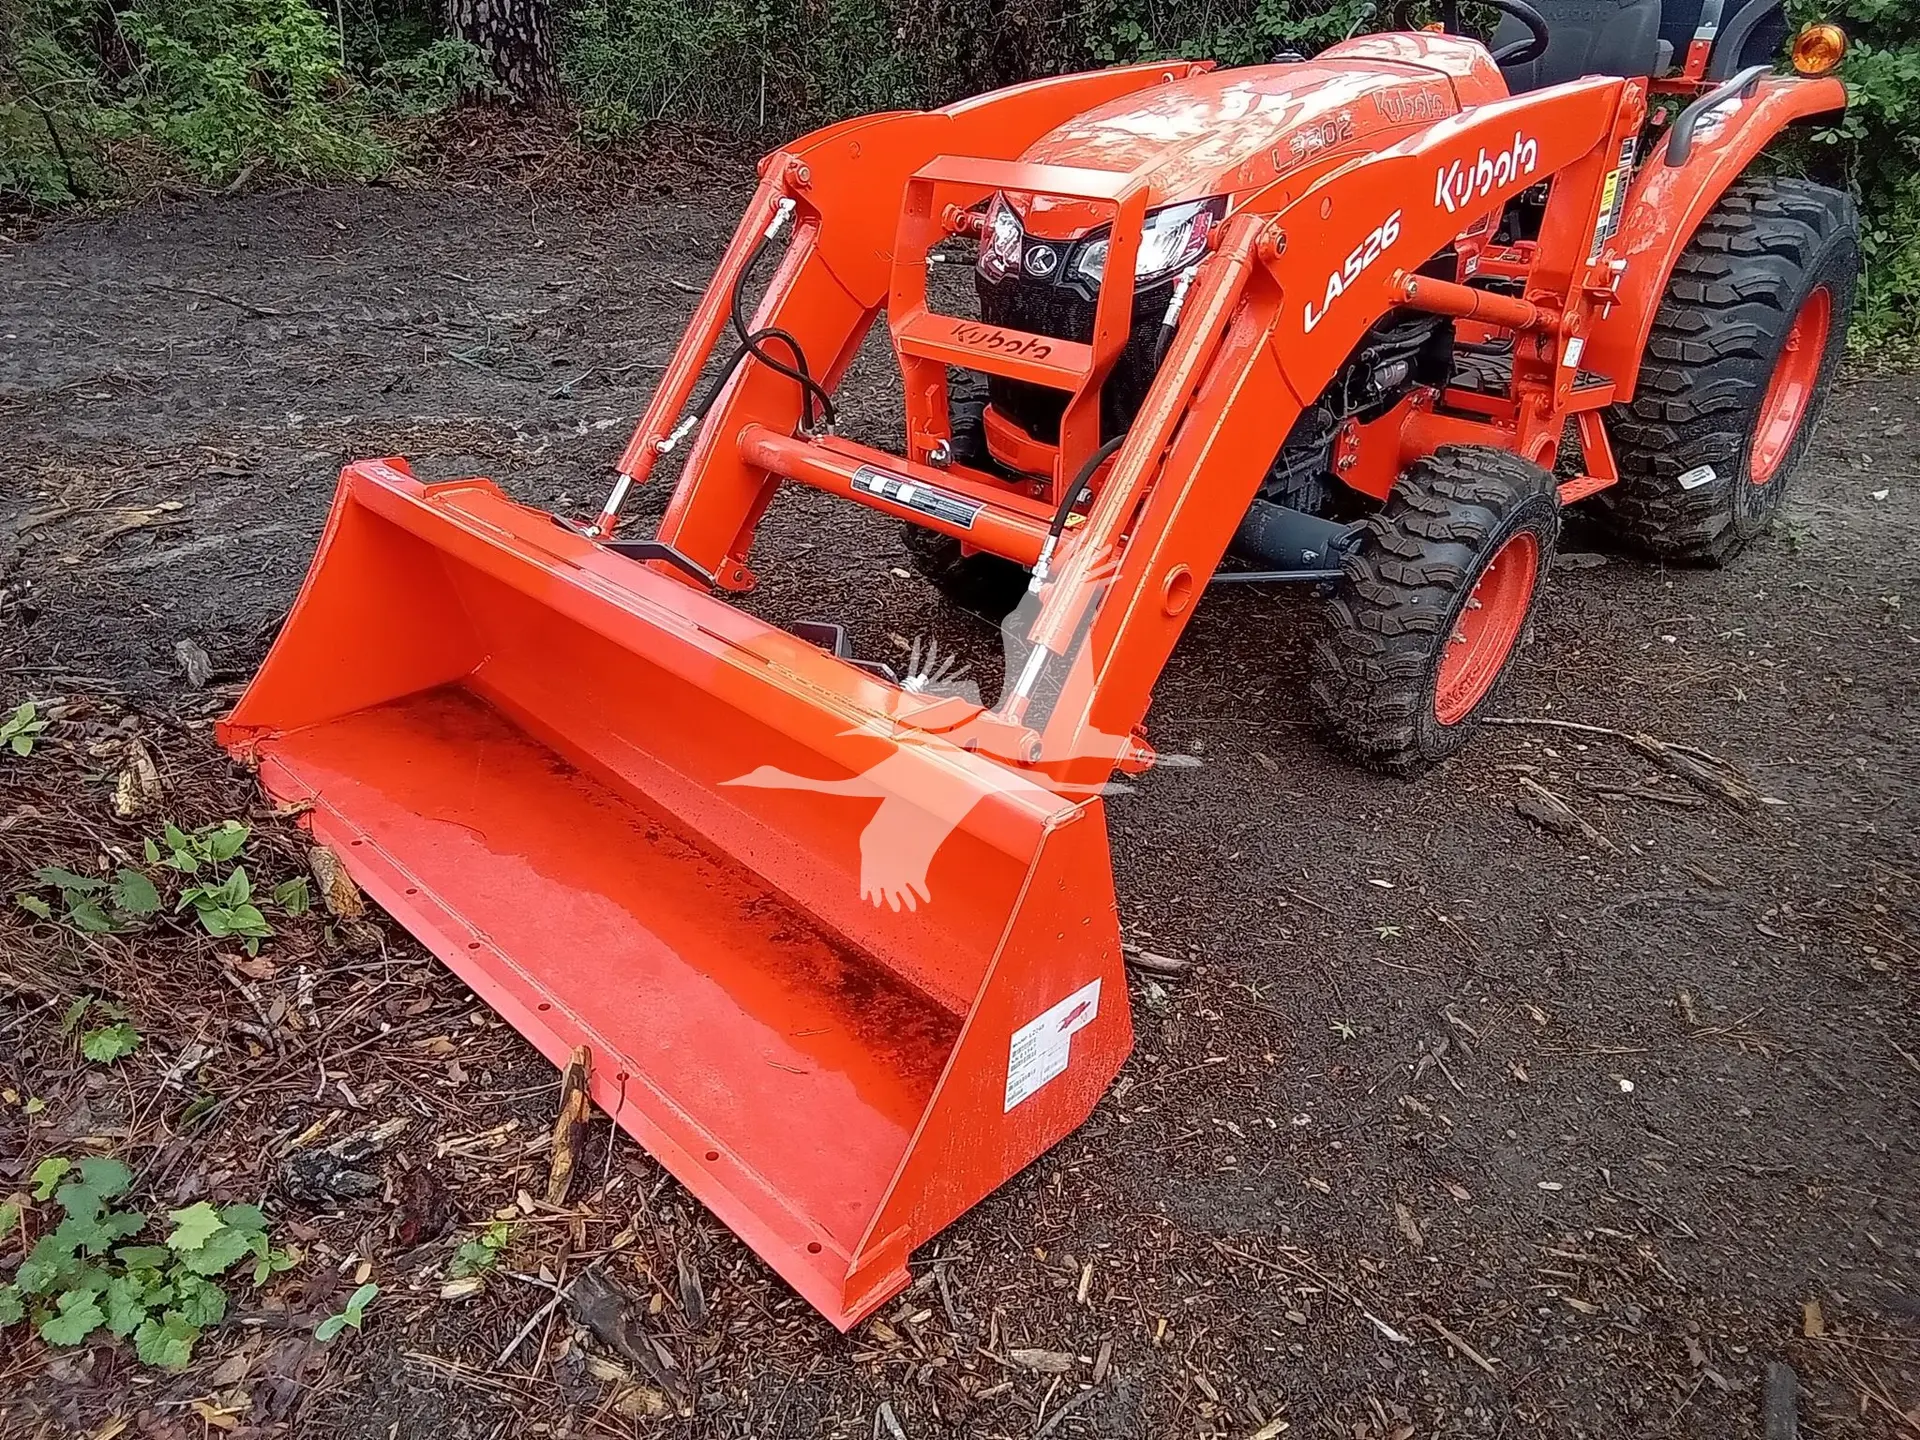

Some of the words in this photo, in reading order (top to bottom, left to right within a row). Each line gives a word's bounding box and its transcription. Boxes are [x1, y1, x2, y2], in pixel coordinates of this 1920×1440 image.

[1372, 88, 1448, 123] Kubota
[1434, 131, 1537, 214] Kubota
[1303, 209, 1402, 334] LA526
[950, 323, 1052, 360] Kubota
